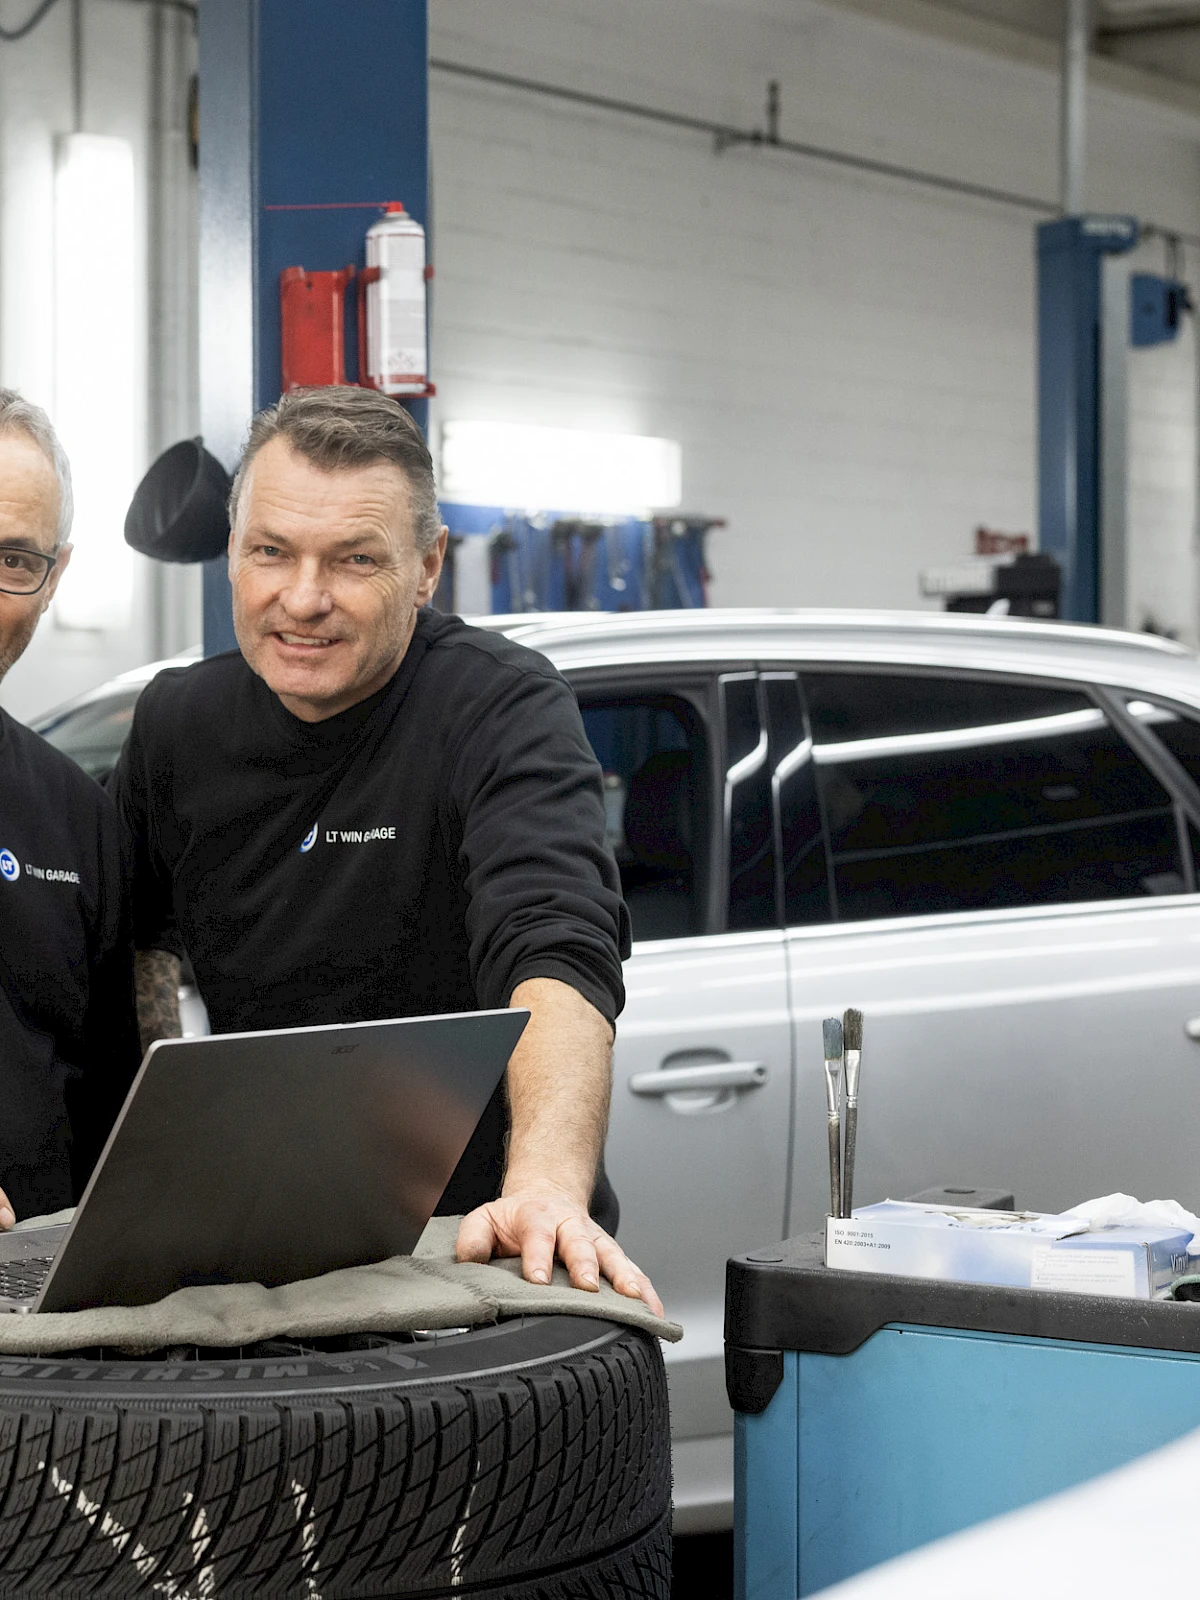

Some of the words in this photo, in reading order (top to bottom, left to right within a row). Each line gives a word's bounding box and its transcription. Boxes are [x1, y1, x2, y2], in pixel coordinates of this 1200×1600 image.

[326, 831, 338, 843] LT
[340, 831, 362, 843] WIN
[363, 827, 396, 843] GAGE
[46, 869, 81, 885] GARAGE
[1171, 1252, 1189, 1274] Vinyl
